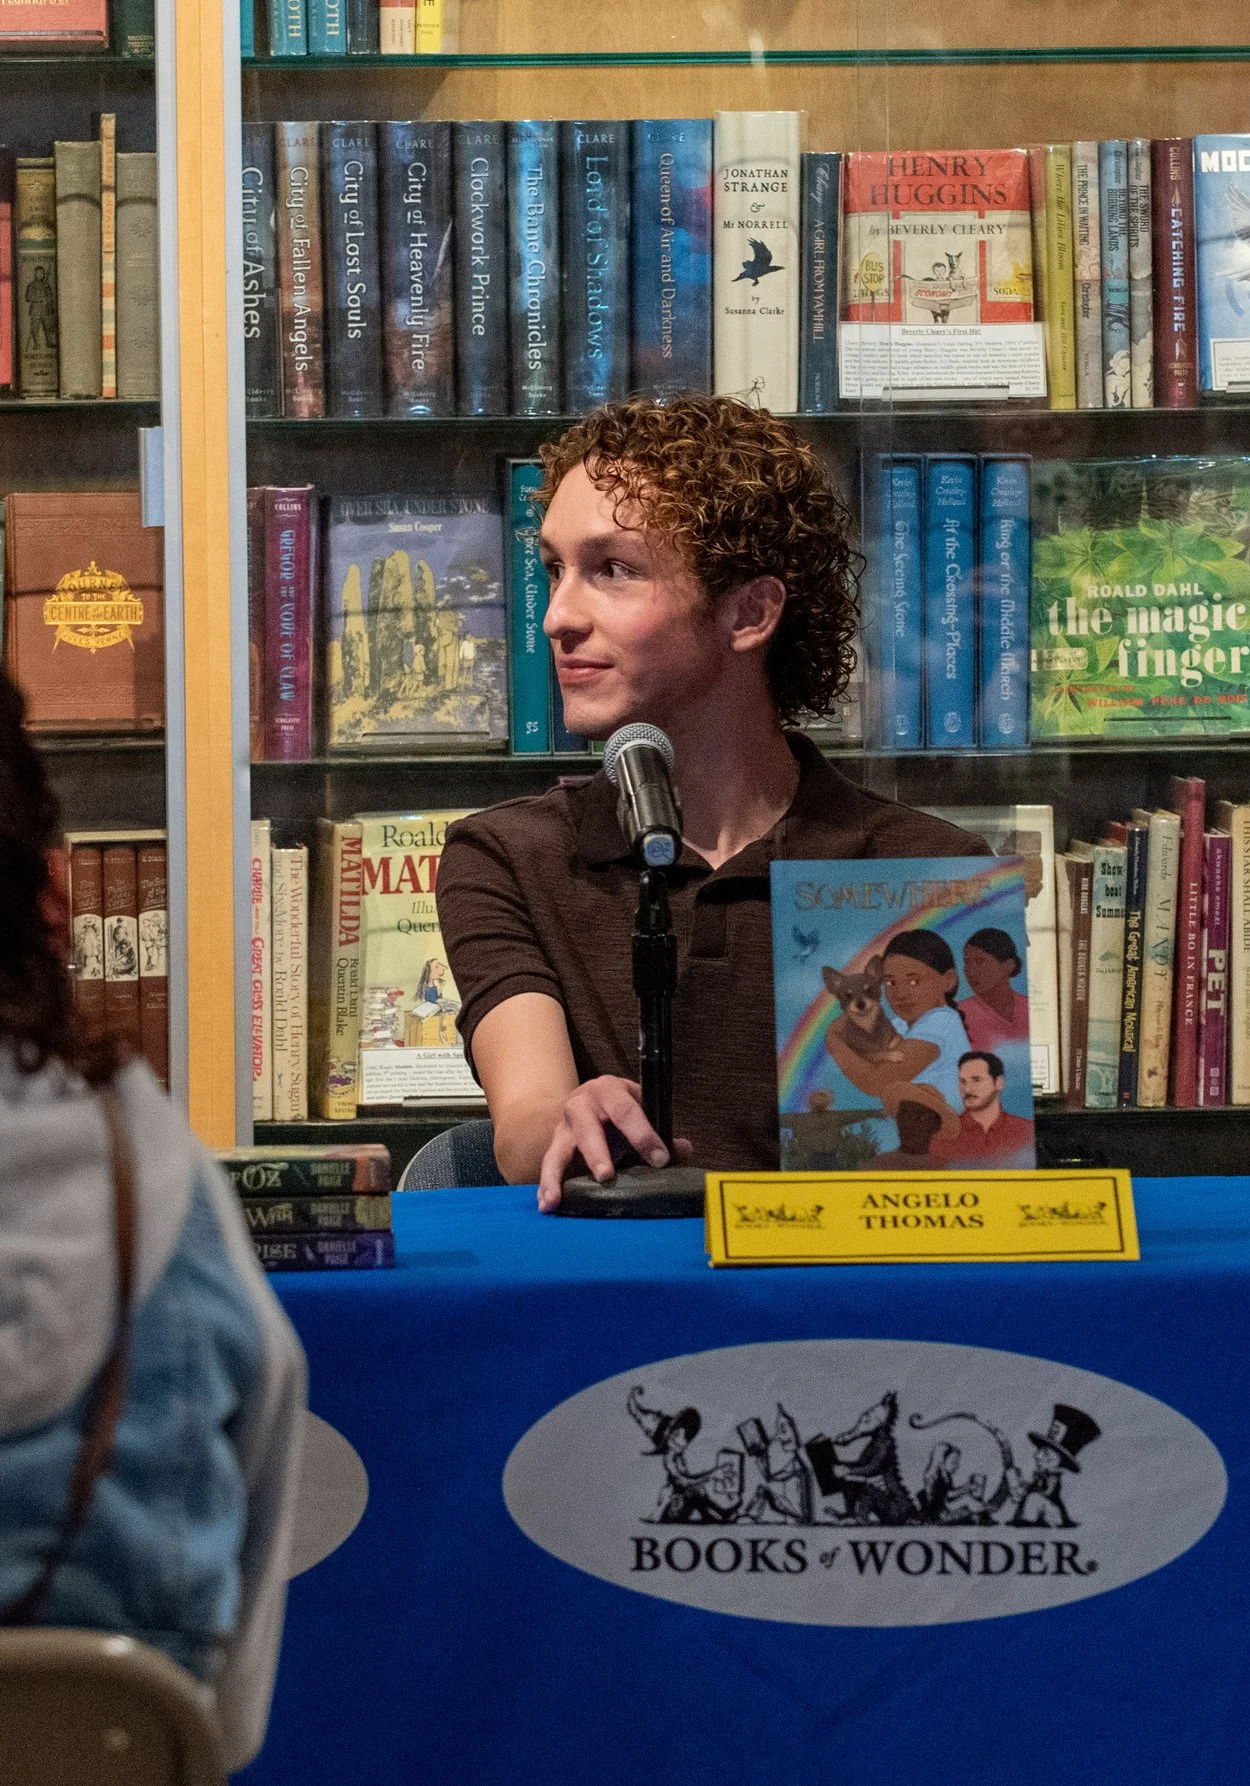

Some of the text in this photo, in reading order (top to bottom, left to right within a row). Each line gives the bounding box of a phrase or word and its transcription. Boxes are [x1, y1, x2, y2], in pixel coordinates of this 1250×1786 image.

[333, 139, 369, 147] CLARE
[396, 140, 433, 149] CLARE
[577, 134, 615, 144] CLARE
[659, 152, 673, 204] Queen
[724, 169, 788, 180] JONATHAN
[890, 156, 994, 177] HENRY
[1078, 165, 1088, 179] THE
[1169, 147, 1180, 181] COLLINS
[285, 166, 308, 209] City
[404, 162, 426, 204] City
[724, 182, 788, 193] STRANGE
[871, 183, 1007, 206] HUGGINS
[1078, 180, 1089, 207] PRINCE
[407, 210, 425, 225] of
[1107, 189, 1120, 251] BURNING LANDS
[1140, 184, 1149, 232] THE SWORD
[290, 214, 307, 232] of
[723, 220, 788, 229] Mr NORRELL
[869, 224, 1005, 236] by BEVERLY CLEARY
[1079, 216, 1089, 246] WAITING
[340, 160, 367, 339] City of Lost Souls
[470, 157, 490, 336] Clockwork Prince
[661, 230, 674, 254] Air
[292, 237, 310, 297] Fallen
[527, 166, 547, 370] The Bane Chronicles
[586, 156, 609, 360] Lord of Shadows
[661, 256, 674, 283] and
[865, 260, 883, 271] BUS
[407, 232, 428, 328] Heavenly
[864, 274, 884, 284] STOP
[661, 286, 675, 359] Darkness
[725, 306, 785, 315] Susanna Clarke
[1173, 295, 1185, 332] FIRE
[289, 302, 313, 372] Angels
[411, 334, 429, 371] Fire
[275, 503, 301, 511] COLLINS
[389, 522, 442, 533] Susan Cooper
[1088, 583, 1203, 598] ROALD DAHL
[50, 606, 137, 620] CENTRE EARTH
[1048, 592, 1246, 643] the magic
[1118, 639, 1250, 688] finger
[339, 837, 362, 949] MATILDA
[795, 880, 993, 911] SOMEWHERE
[1105, 884, 1122, 897] boat
[397, 919, 440, 935] Quen
[1129, 911, 1141, 928] The
[1126, 931, 1141, 961] Great
[1185, 882, 1198, 1025] LITTLE BO IN FRANCE
[336, 957, 349, 1036] Quentin Blake
[1124, 967, 1140, 1010] American
[1207, 949, 1227, 1017] PET
[862, 1193, 979, 1209] ANGELO
[859, 1215, 985, 1230] THOMAS
[630, 1537, 808, 1574] BOOKS
[819, 1546, 842, 1568] of
